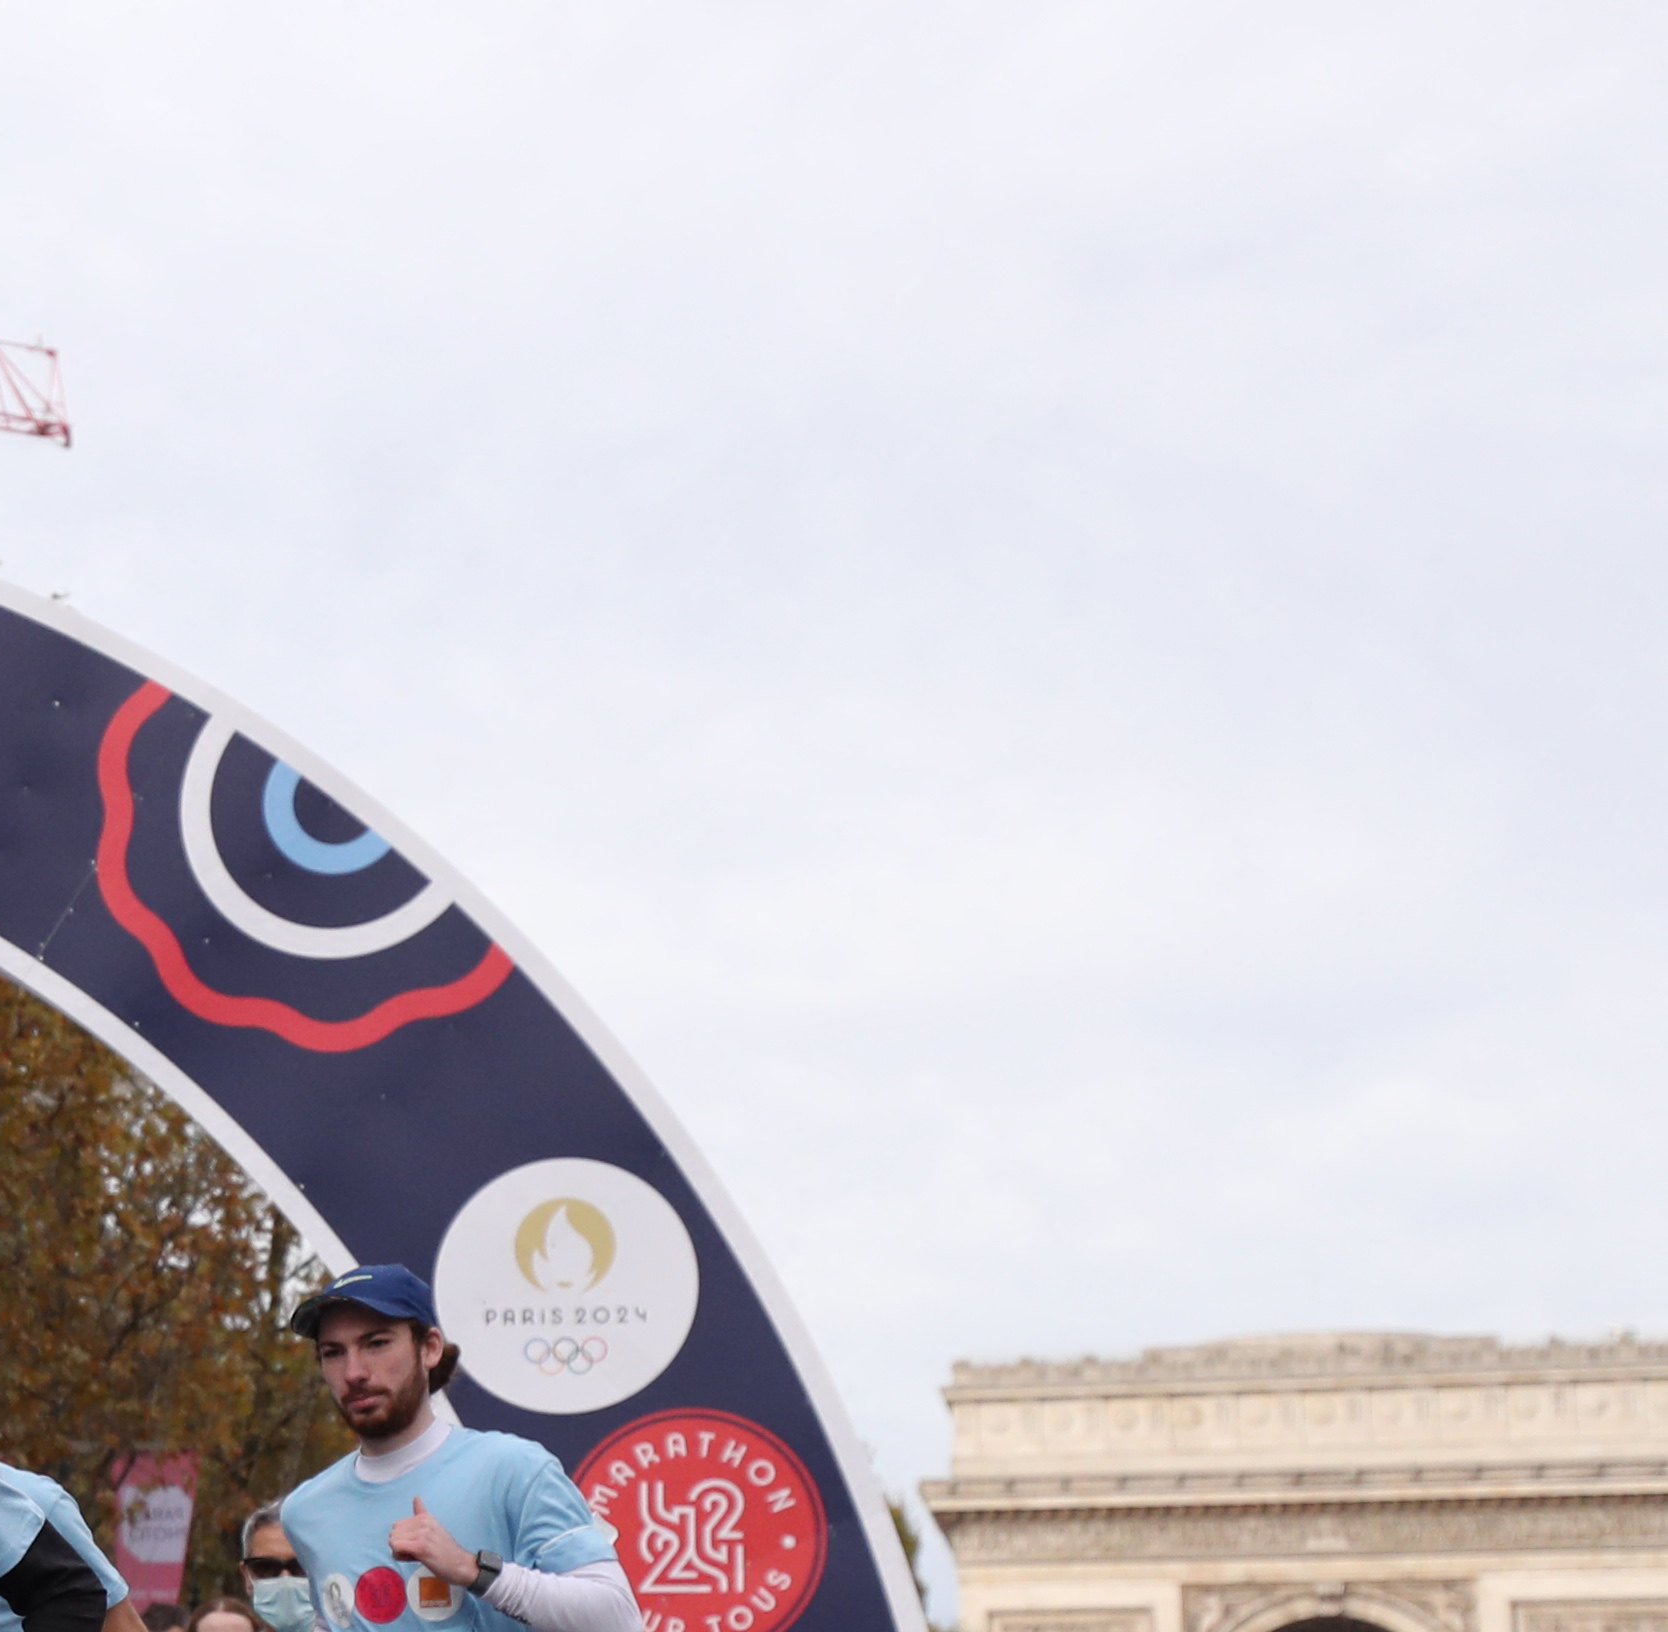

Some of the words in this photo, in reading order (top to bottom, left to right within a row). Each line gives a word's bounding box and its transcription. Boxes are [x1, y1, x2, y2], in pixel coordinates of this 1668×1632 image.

[484, 1307, 564, 1327] PARIS
[574, 1305, 648, 1325] 2024
[588, 1430, 798, 1516] MARATHON
